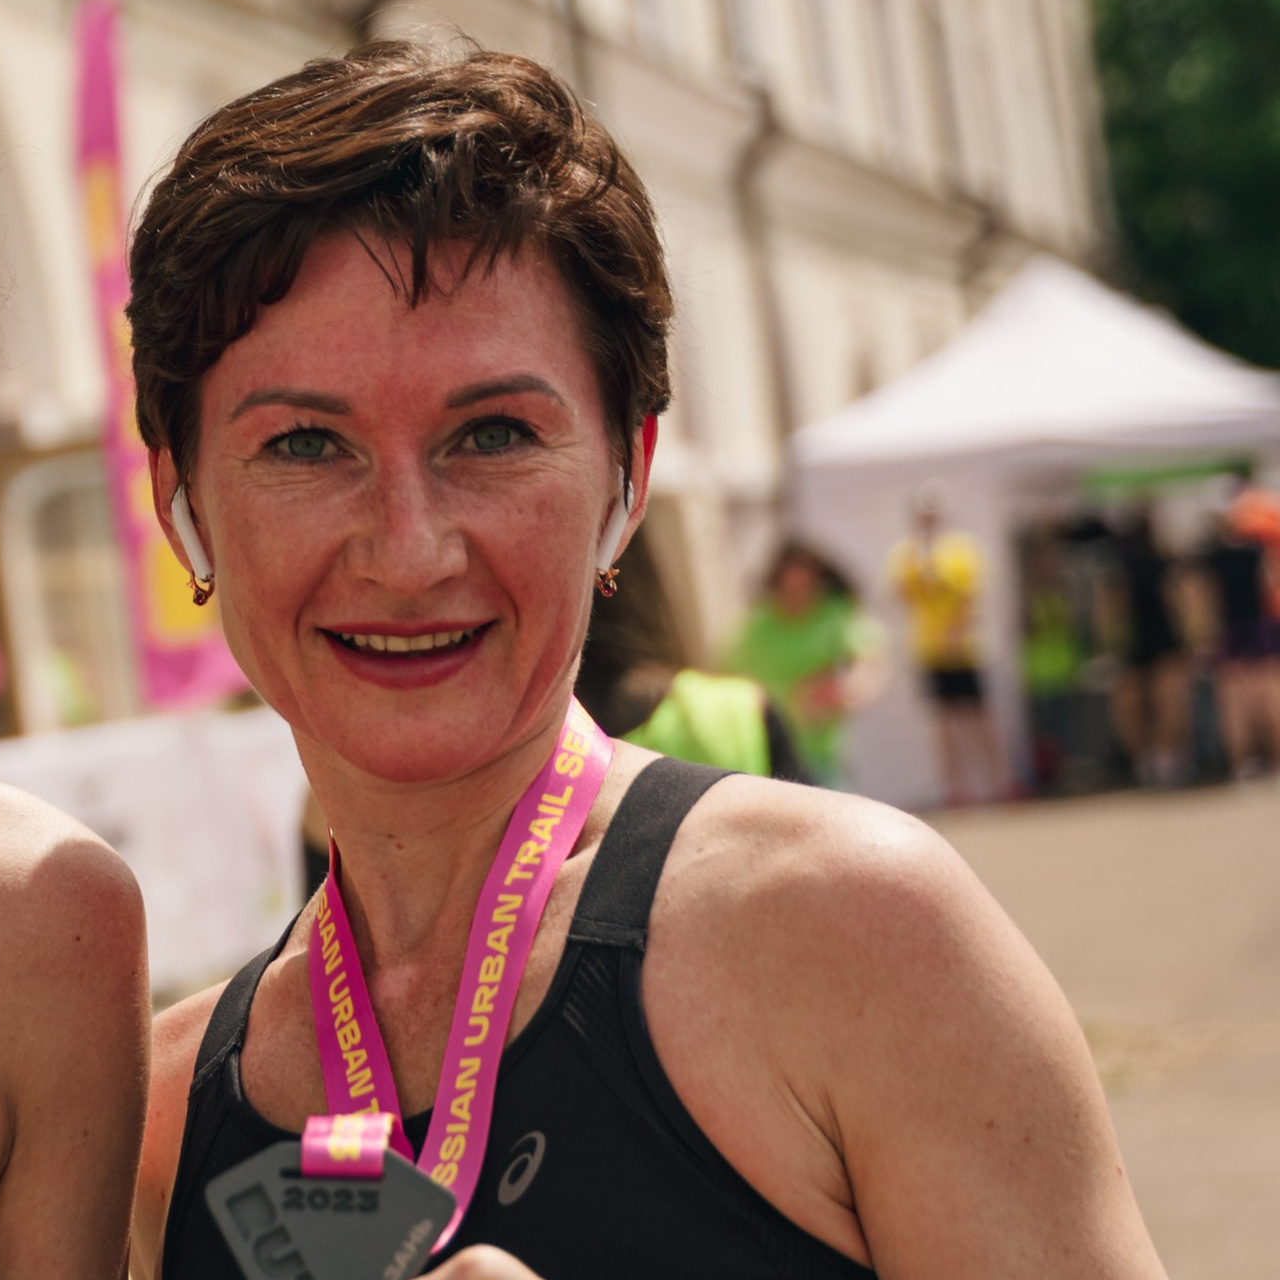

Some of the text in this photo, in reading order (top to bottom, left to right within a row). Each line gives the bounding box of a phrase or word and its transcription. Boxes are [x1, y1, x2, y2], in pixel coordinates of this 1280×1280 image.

[329, 971, 375, 1099] URBAN
[430, 1057, 481, 1188] SSIAN
[464, 893, 523, 1047] URBAN
[503, 783, 574, 887] TRAIL
[282, 1186, 380, 1213] 2023
